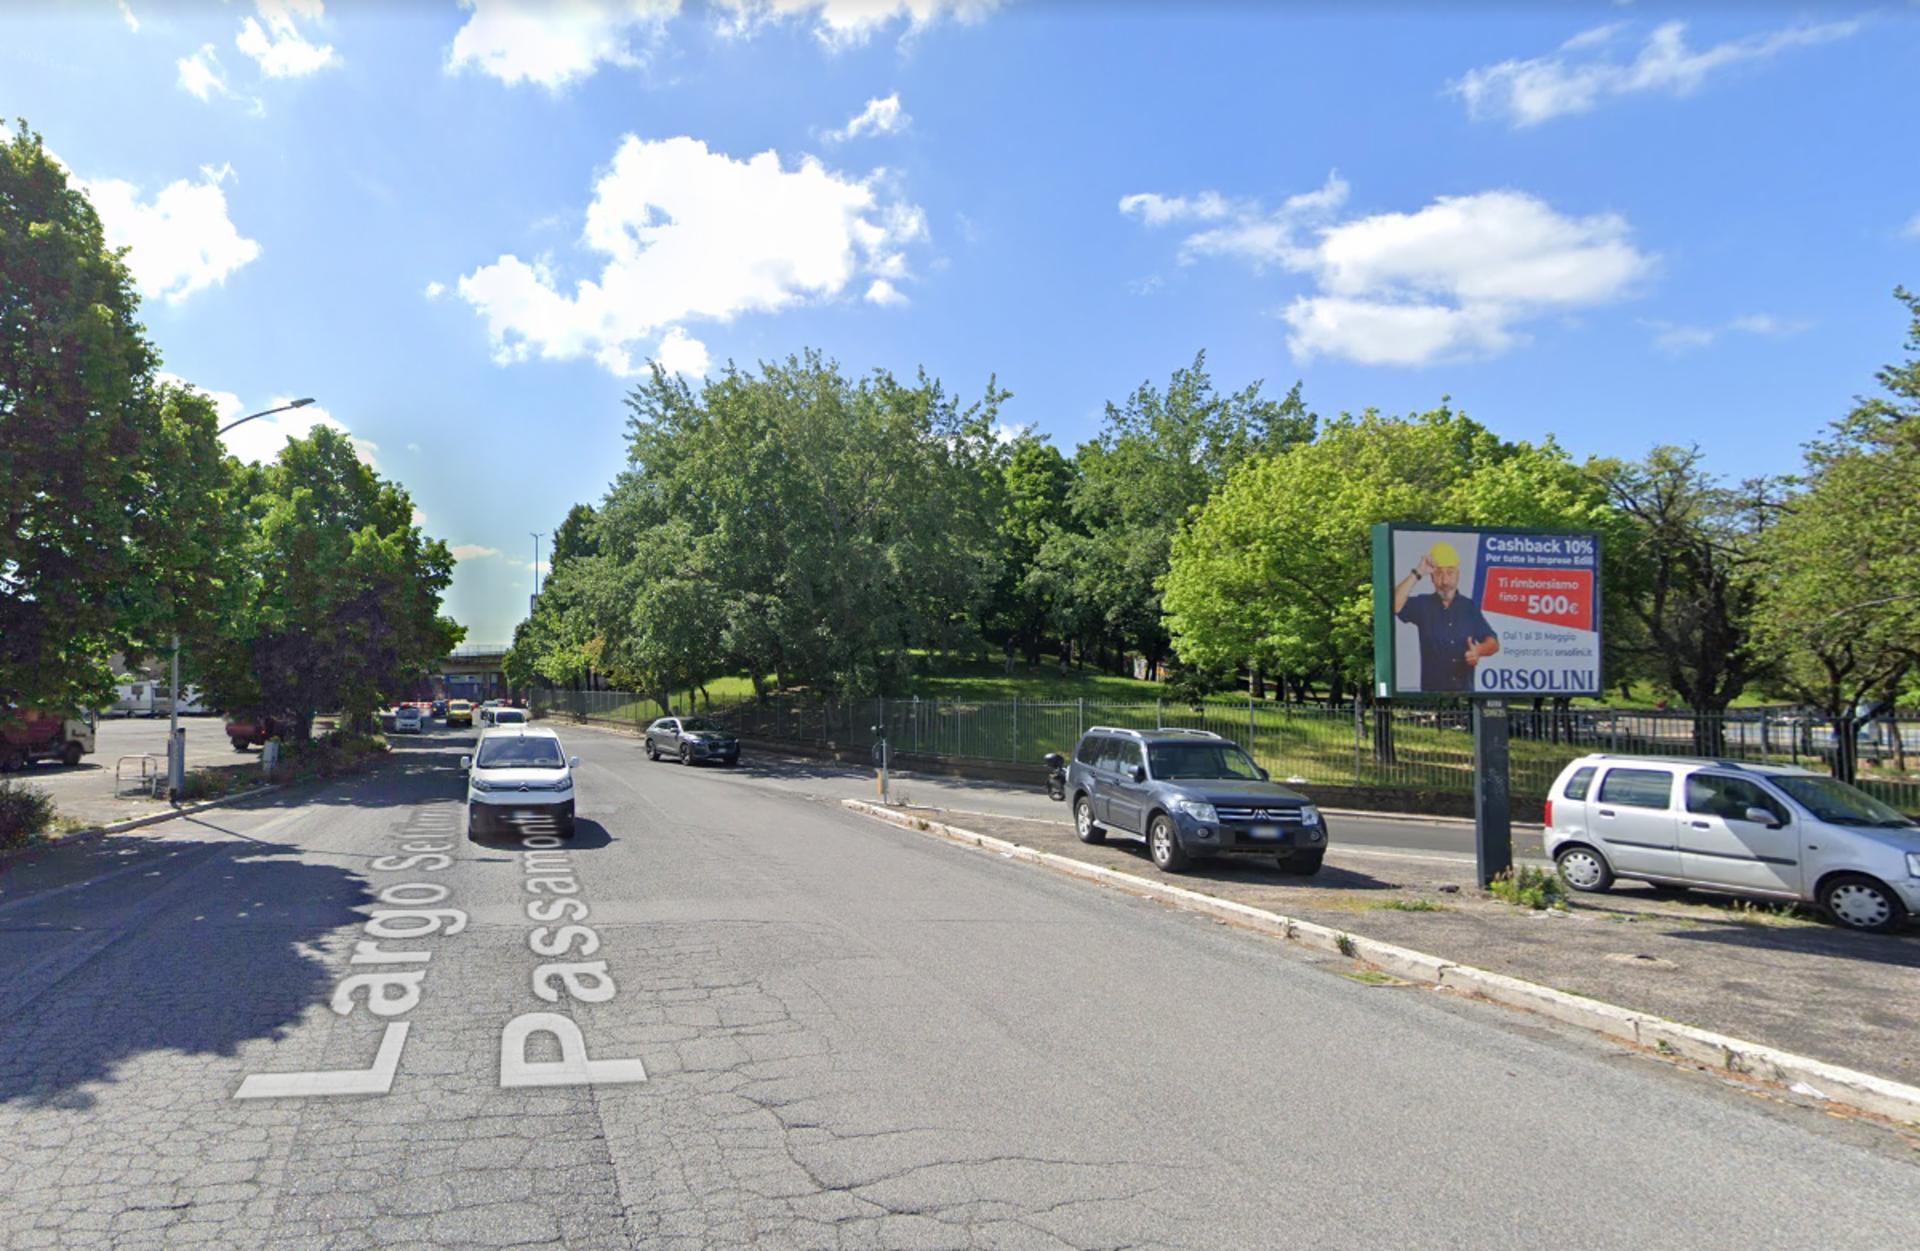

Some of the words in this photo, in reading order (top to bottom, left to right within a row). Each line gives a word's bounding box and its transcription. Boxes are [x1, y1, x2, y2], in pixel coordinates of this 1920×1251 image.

[1485, 537, 1561, 553] Cashback
[1564, 540, 1595, 555] 10%
[1485, 553, 1500, 563] Per
[1498, 577, 1509, 588] Ti
[1510, 577, 1580, 591] rimborsiamo
[1499, 592, 1518, 602] fino
[1519, 594, 1526, 602] a
[1503, 631, 1517, 641] Dal
[1544, 632, 1577, 643] Maggio
[1503, 647, 1541, 658] Registrati
[1481, 668, 1595, 690] ORSOLINI
